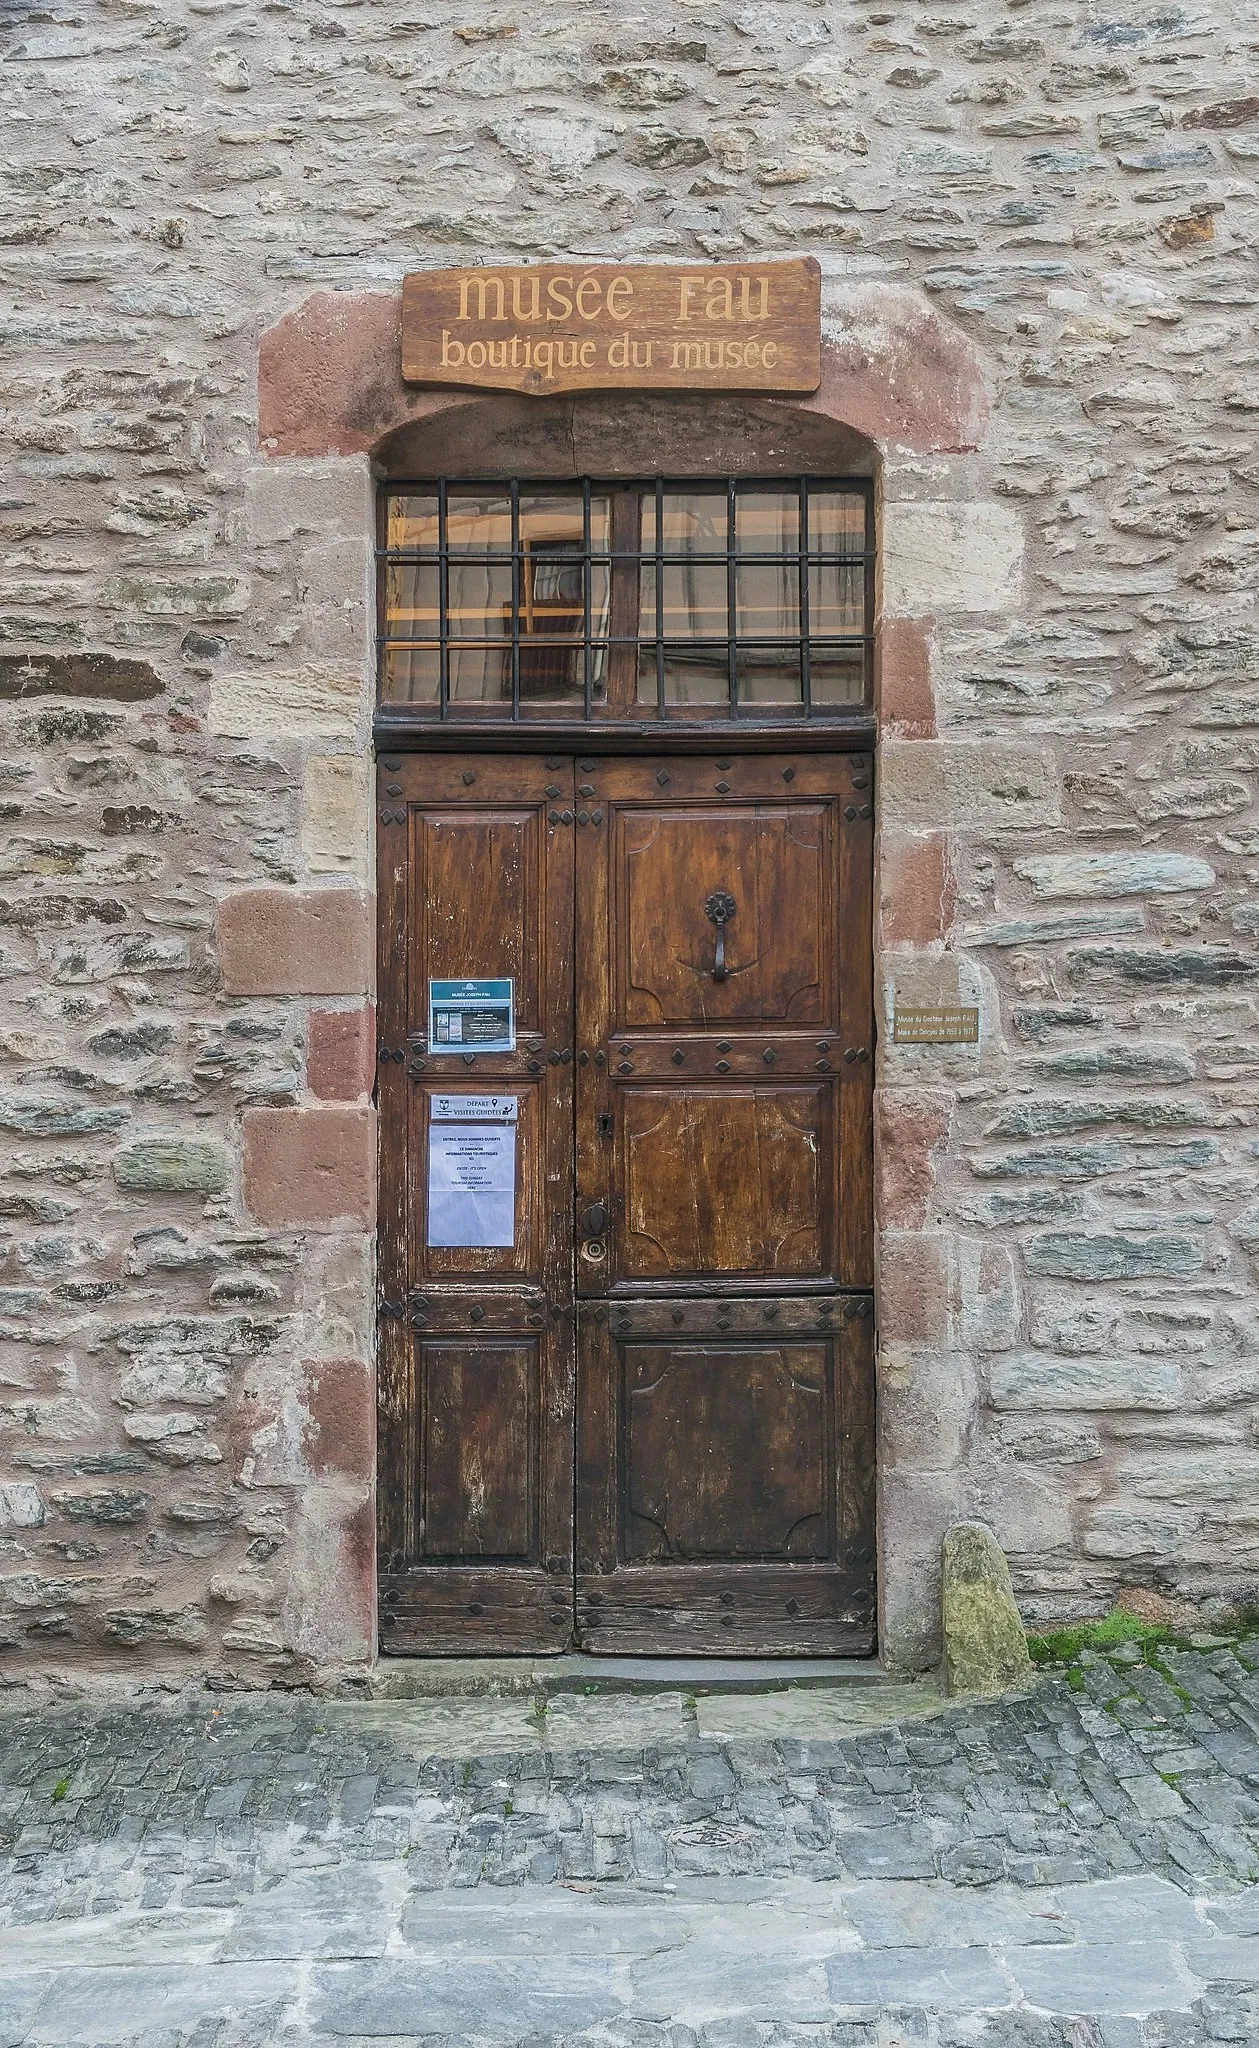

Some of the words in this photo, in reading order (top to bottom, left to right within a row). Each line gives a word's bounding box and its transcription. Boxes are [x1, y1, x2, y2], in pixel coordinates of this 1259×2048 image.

[440, 329, 597, 380] boutique
[606, 331, 653, 369] du
[670, 334, 779, 370] musée
[897, 1015, 914, 1023] Musée
[945, 1015, 961, 1023] Joseph
[897, 1028, 911, 1036] Maire
